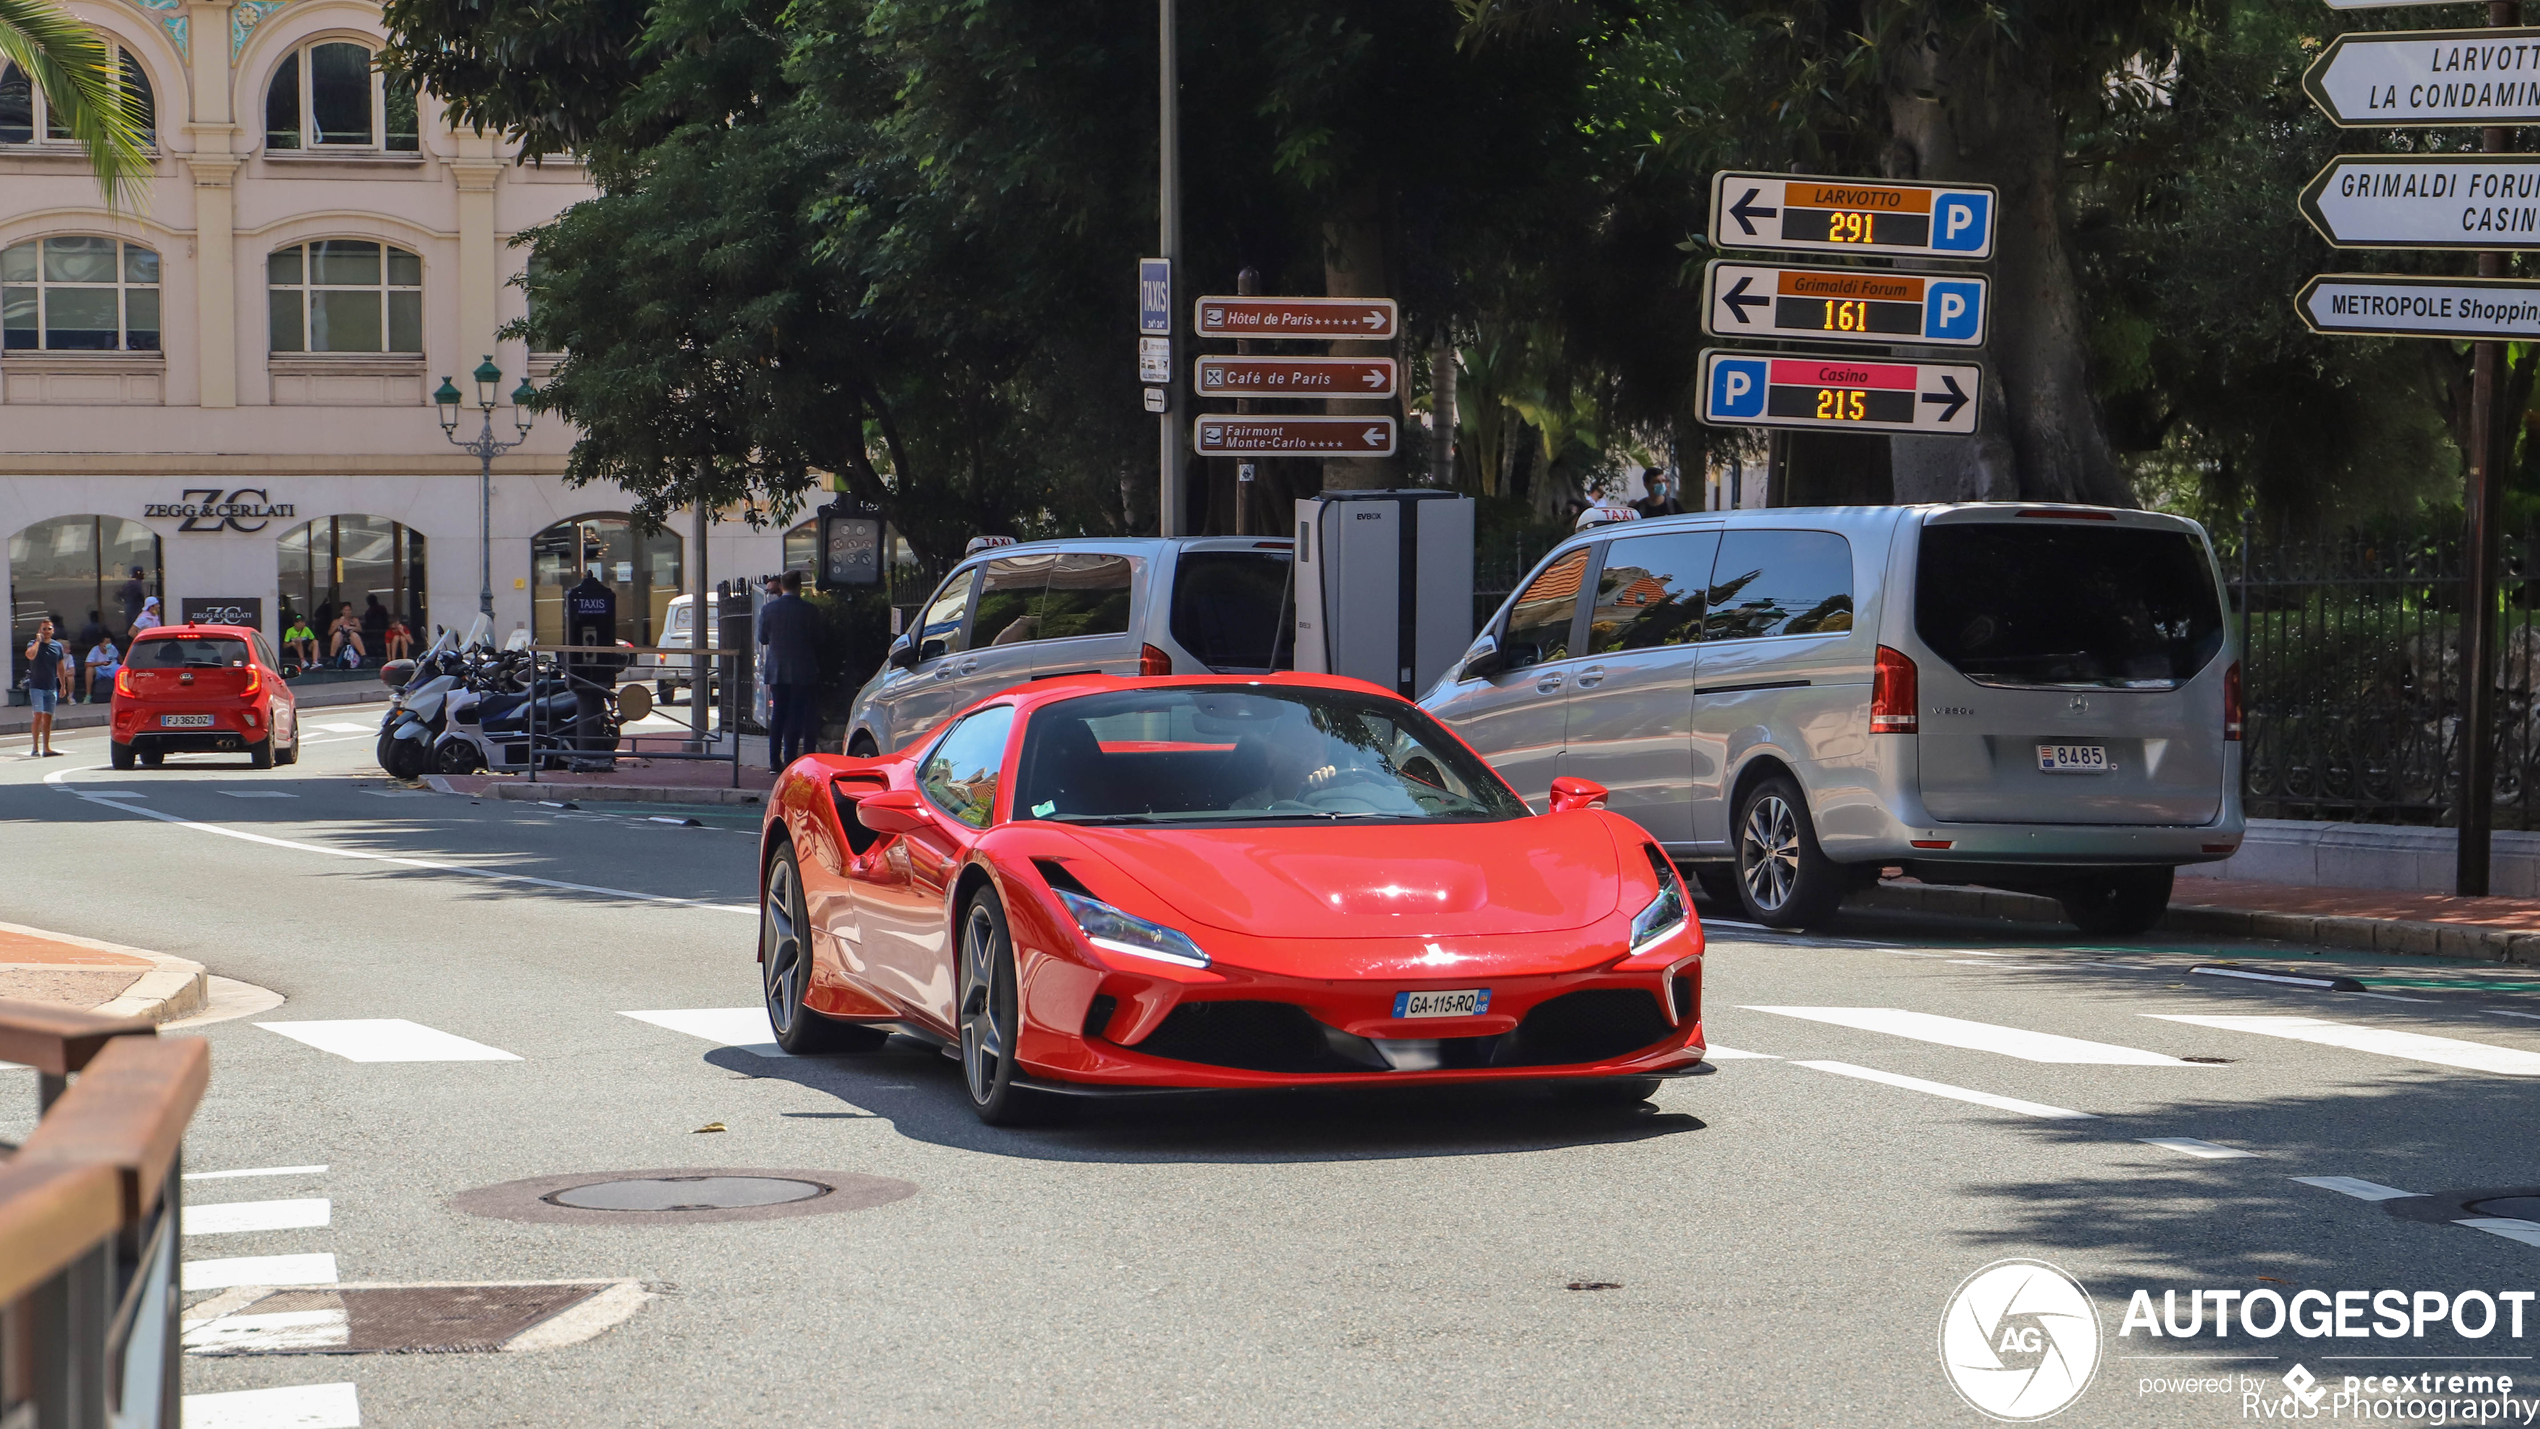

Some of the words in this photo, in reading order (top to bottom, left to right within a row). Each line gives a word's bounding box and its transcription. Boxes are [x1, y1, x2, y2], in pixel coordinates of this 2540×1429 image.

[2369, 85, 2396, 109] LA
[2341, 173, 2457, 198] GRIMALDI
[2469, 173, 2540, 198] FORU
[1814, 188, 1901, 207] LARVOTTO
[1829, 211, 1873, 243] 291
[1946, 204, 1973, 240] P
[2462, 207, 2540, 232] CASIN
[1794, 277, 1858, 295] Grimaldi
[1861, 280, 1907, 297] Forum
[1143, 281, 1166, 313] TAXIS
[1227, 311, 1261, 326] Hôtel
[1264, 313, 1279, 326] de
[1282, 312, 1314, 326] Paris
[1823, 300, 1867, 331] 161
[1939, 292, 1966, 328] P
[2332, 294, 2452, 318] METROPOLE
[2458, 298, 2540, 325] Shoppin
[1227, 369, 1261, 385] Café
[1268, 371, 1285, 385] de
[1292, 371, 1331, 385] Paris
[1818, 367, 1868, 383] Casino
[1725, 370, 1752, 406] P
[1816, 389, 1867, 420] 215
[1225, 425, 1284, 437] Fairmont
[1225, 436, 1307, 449] Monte-Carlo
[144, 504, 197, 518] ZEGG
[216, 504, 295, 518] CERLATI
[178, 489, 268, 533] ZC
[1602, 510, 1634, 520] TAXI
[984, 538, 1011, 546] TAXI
[579, 598, 605, 609] TAXIS
[167, 716, 208, 725] FJ-362-DZ
[2058, 747, 2102, 765] 8485
[1410, 994, 1474, 1013] GA-115-RQ
[1474, 1004, 1488, 1012] 06
